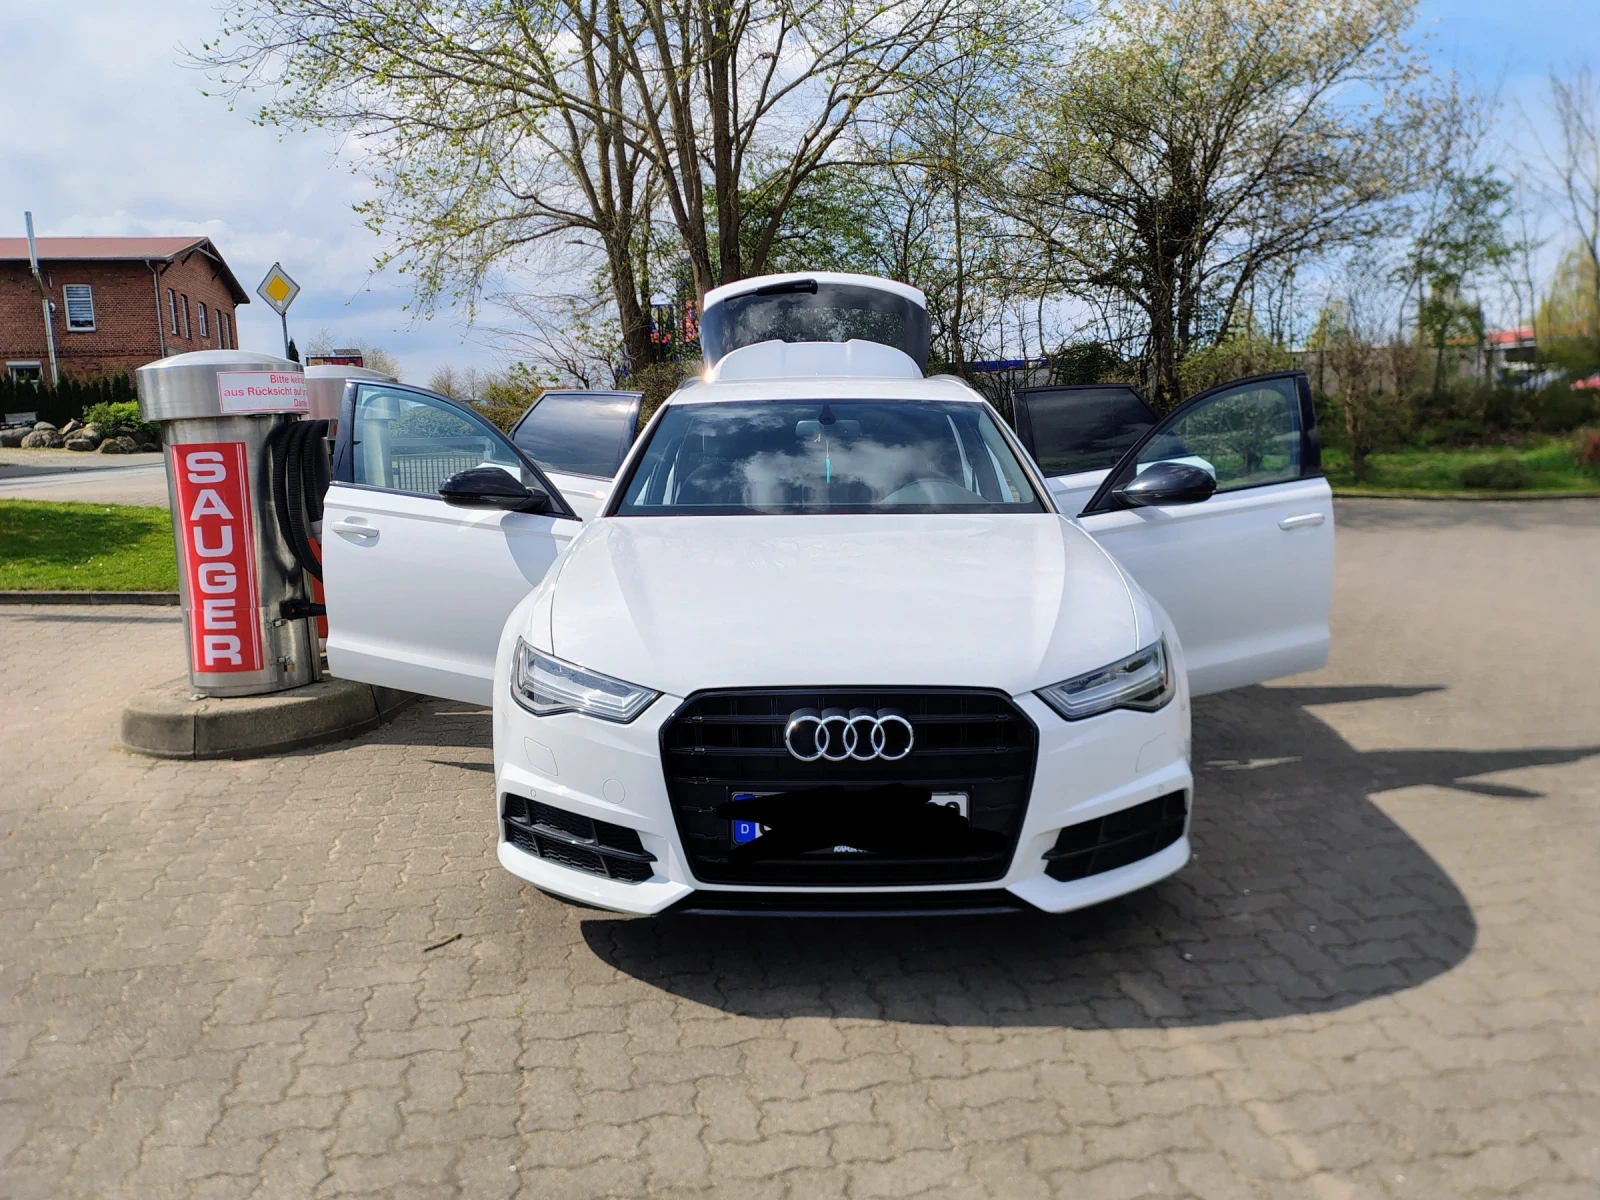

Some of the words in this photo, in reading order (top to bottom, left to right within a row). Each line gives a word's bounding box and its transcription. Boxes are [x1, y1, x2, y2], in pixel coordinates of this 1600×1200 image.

[270, 375, 289, 384] Bitte
[247, 387, 292, 396] Rücksicht
[186, 451, 242, 666] SAUGER
[740, 823, 749, 834] D
